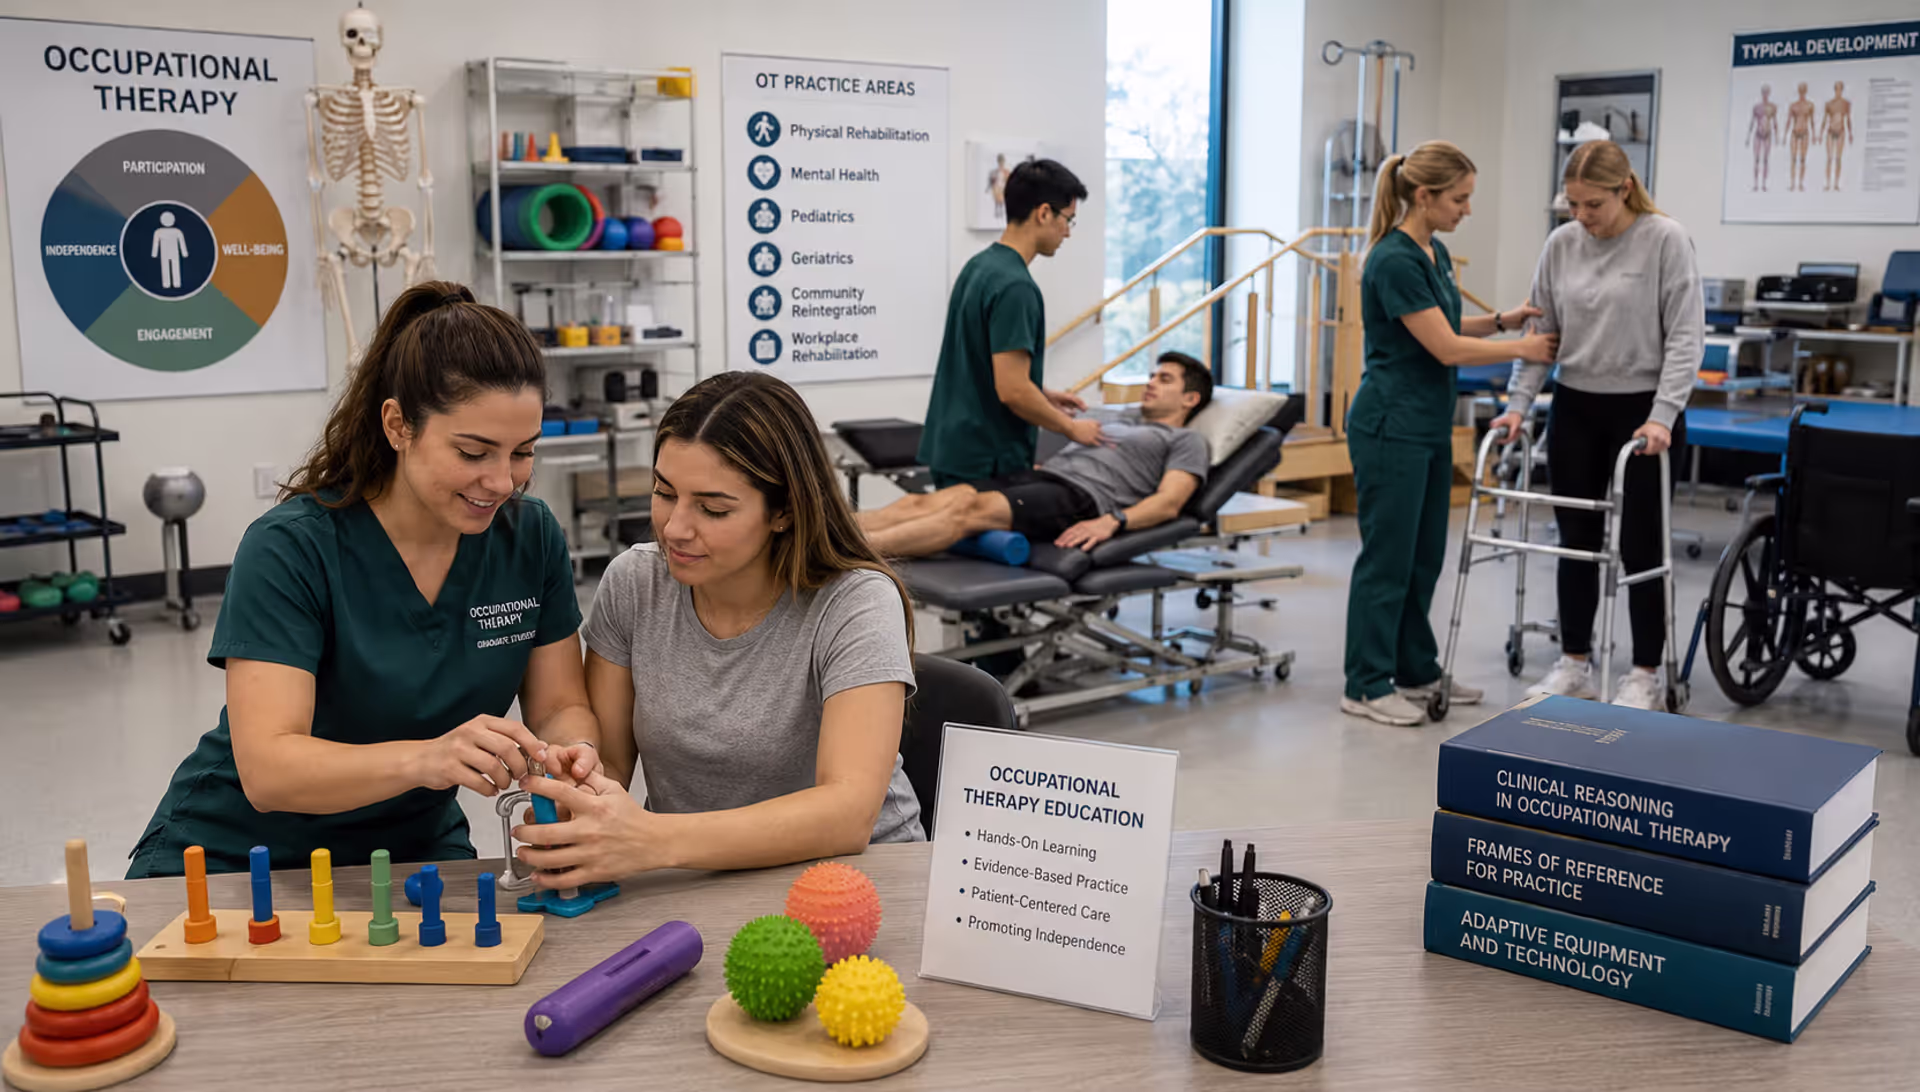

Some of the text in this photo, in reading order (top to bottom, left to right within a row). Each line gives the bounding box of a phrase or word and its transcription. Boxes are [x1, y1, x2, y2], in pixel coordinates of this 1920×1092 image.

[1742, 32, 1919, 59] TYPICAL DEVELOPMENT
[44, 45, 278, 82] OCCUPATIONAL
[756, 73, 916, 96] OT PRACTICE AREAS
[94, 85, 238, 116] THERAPY
[790, 124, 930, 143] Physical Rehabilitation
[122, 160, 206, 175] PARTICIPATION
[791, 167, 880, 182] Mental Health
[791, 209, 855, 224] Pediatrics
[45, 244, 117, 257] INDEPENDENCE
[222, 244, 284, 257] WELL-BEING
[791, 251, 854, 266] Geriatrics
[791, 286, 864, 302] Community
[791, 303, 876, 320] Reintegration
[137, 327, 213, 342] ENGAGEMENT
[792, 331, 858, 347] Workplace
[792, 347, 878, 363] Rehabilitation
[470, 597, 540, 618] OCCUPATIONAL
[478, 613, 522, 630] THERAPY
[990, 765, 1120, 799] OCCUPATIONAL
[1496, 769, 1674, 819] CLINICAL REASONING
[963, 788, 1144, 829] THERAPY EDUCATION
[1495, 792, 1731, 853] IN OCCUPATIONAL THERAPY
[976, 829, 1097, 862] Hands-On Learning
[974, 857, 1128, 895] Evidence-Based Practice
[1467, 837, 1664, 896] FRAMES OF REFERENCE
[1465, 861, 1583, 901] FOR PRACTICE
[971, 886, 1111, 923] Patient-Centered Care
[968, 915, 1126, 956] Promoting Independence
[1460, 909, 1666, 974] ADAPTIVE EQUIPMENT
[1460, 933, 1634, 990] AND TECHNOLOGY
